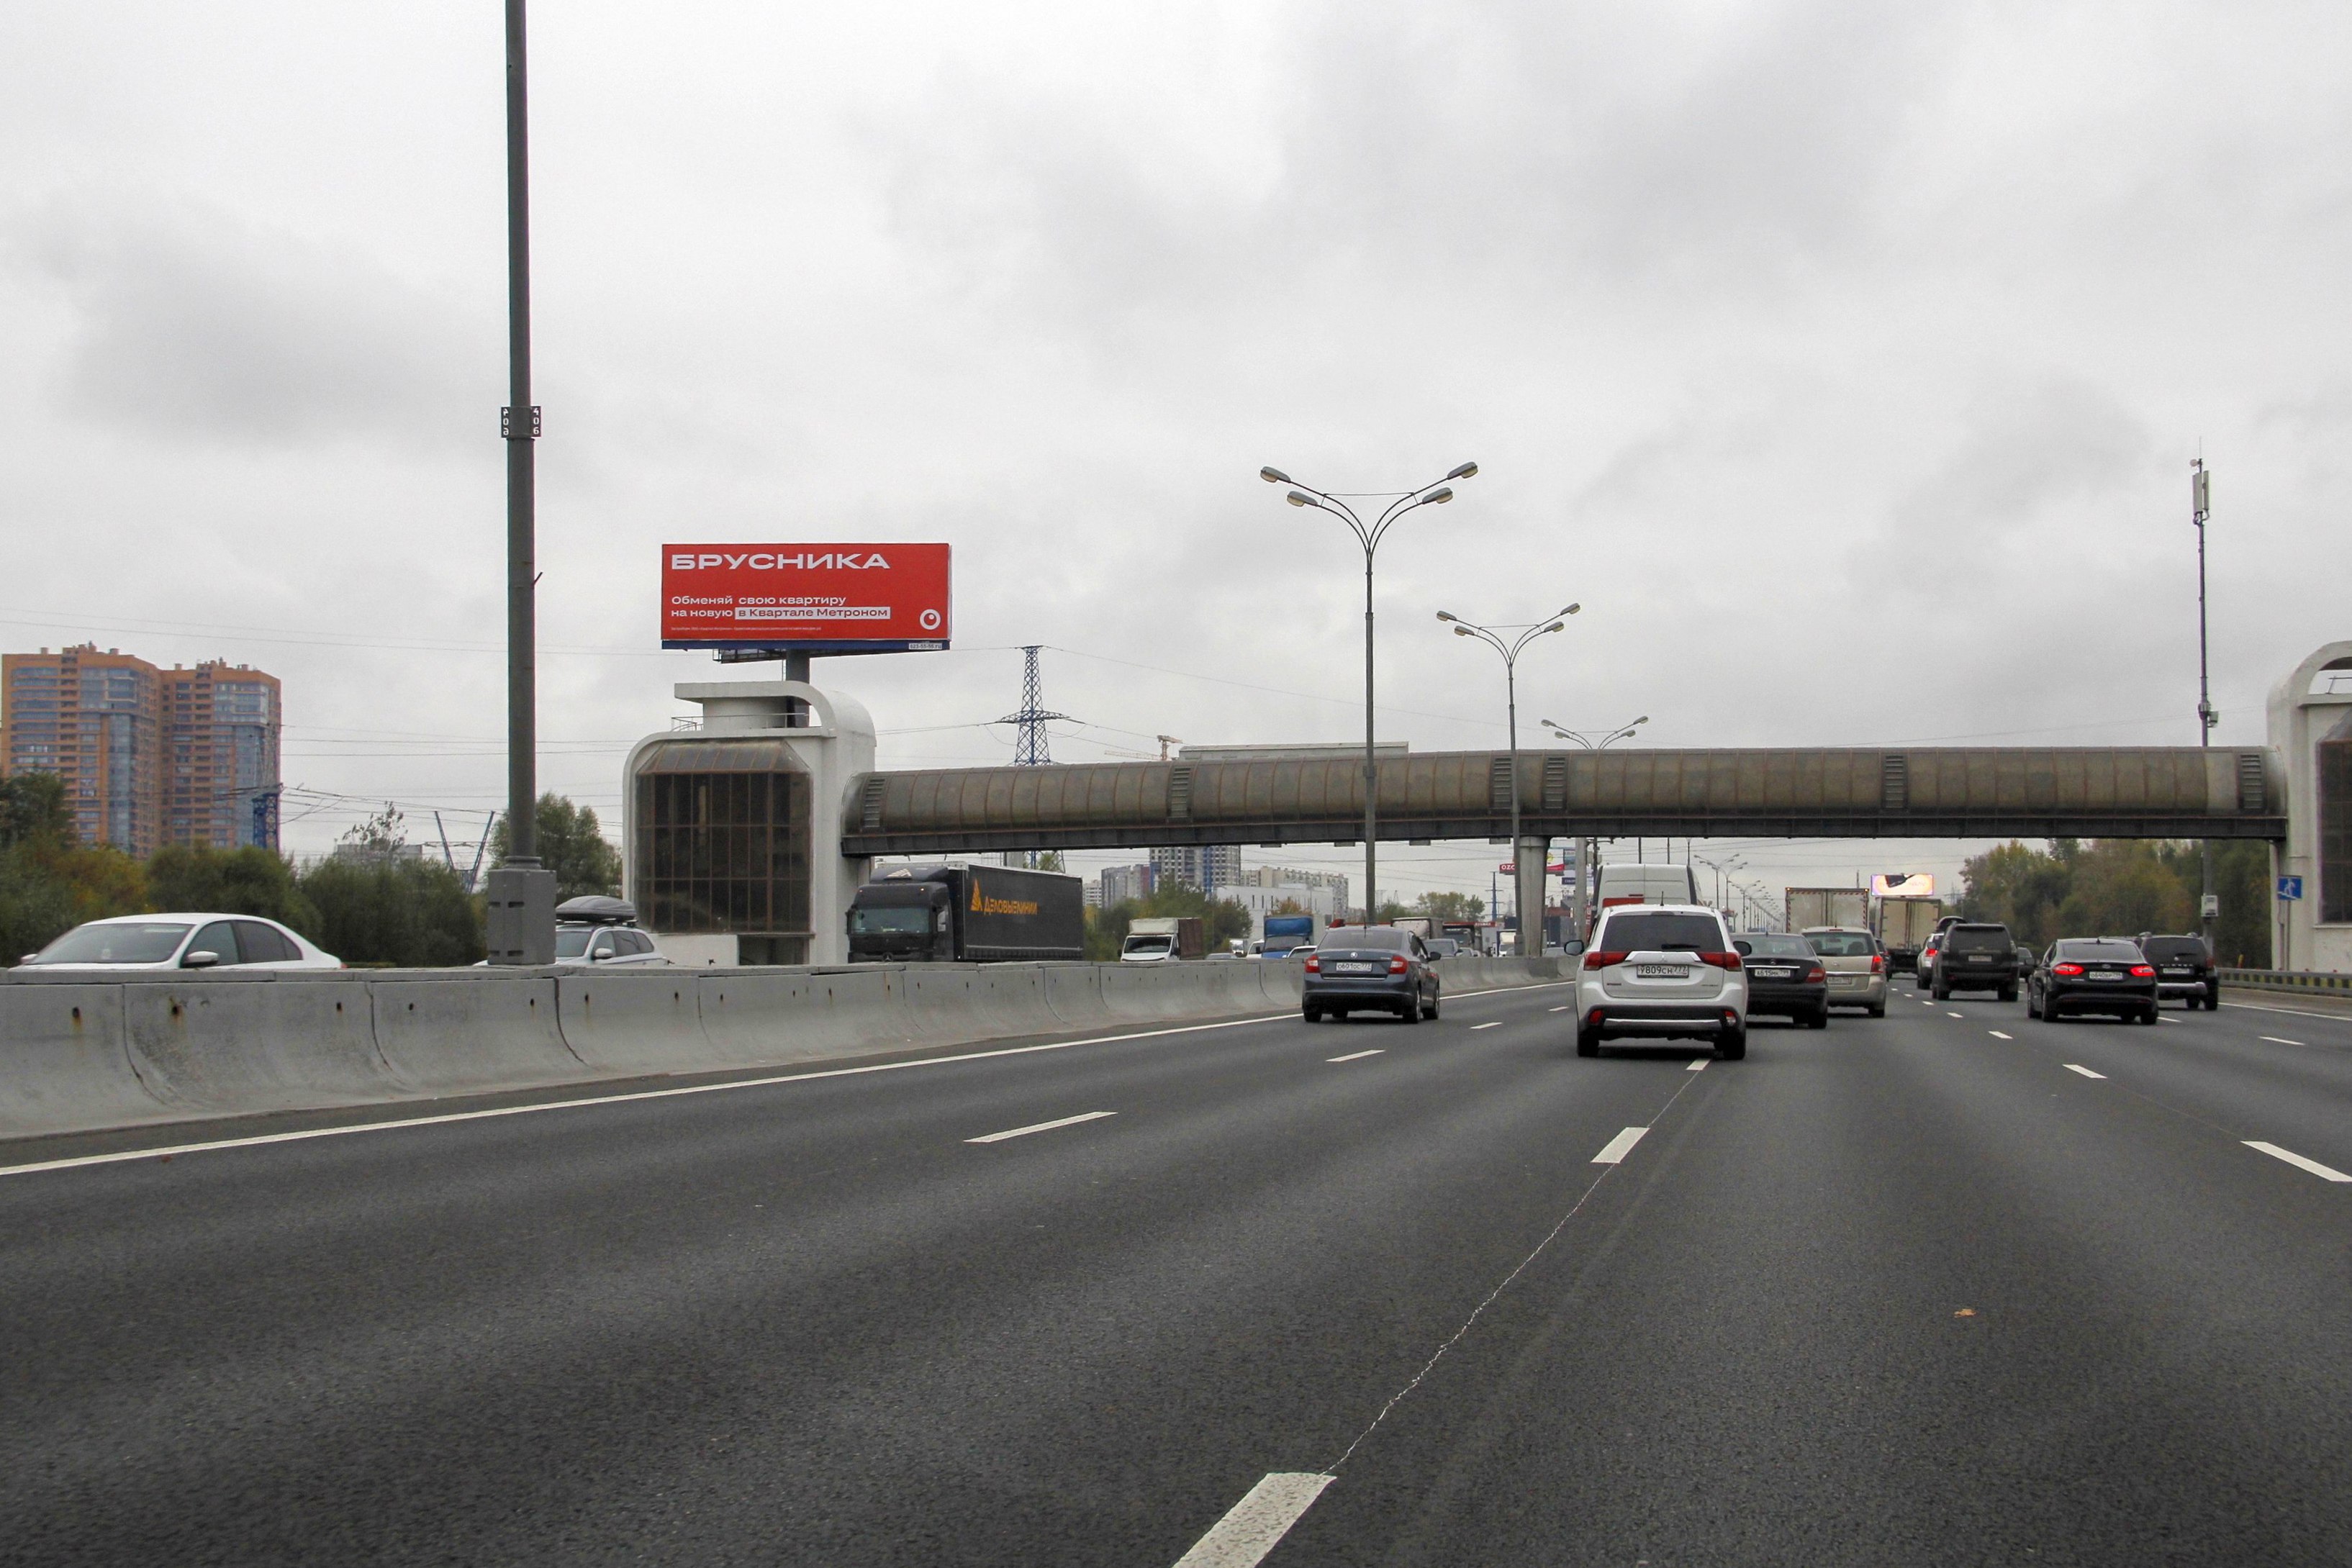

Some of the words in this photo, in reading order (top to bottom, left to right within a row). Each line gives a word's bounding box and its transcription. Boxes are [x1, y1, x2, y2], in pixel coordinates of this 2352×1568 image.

[671, 553, 890, 570] БРУСНИКА
[671, 596, 733, 604] Обменяй
[779, 597, 846, 606] квартиру
[690, 609, 733, 619] новую
[749, 608, 813, 618] Квартале
[817, 608, 888, 618] Метроном
